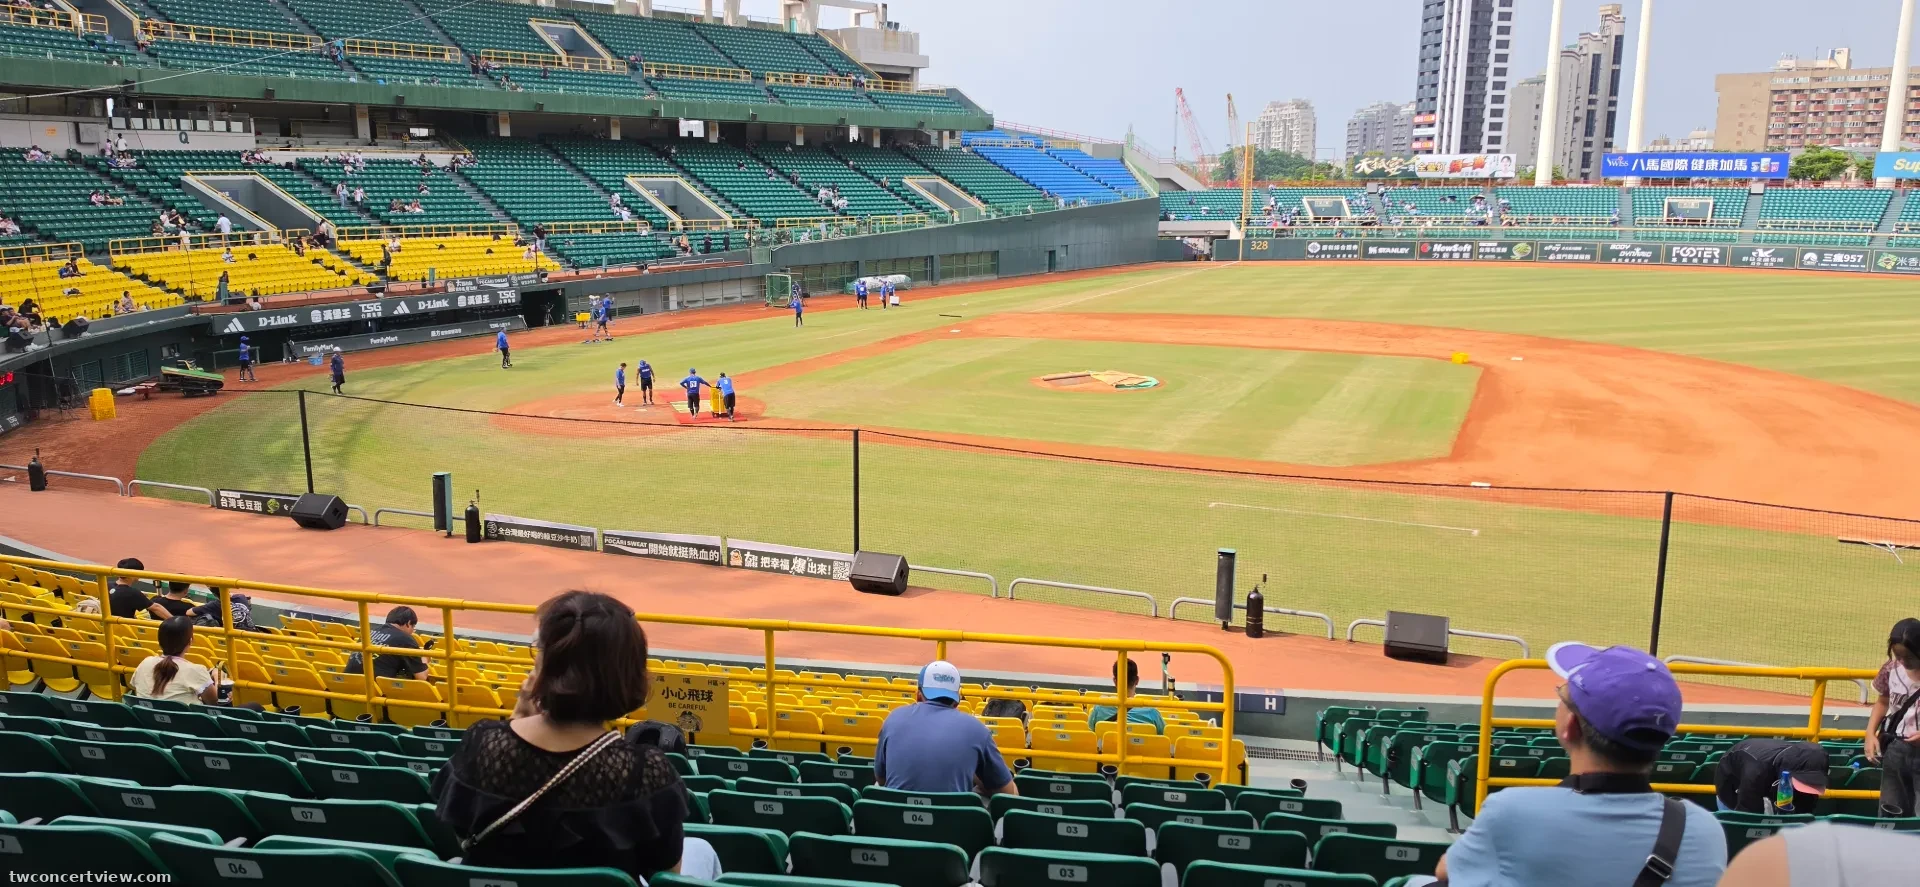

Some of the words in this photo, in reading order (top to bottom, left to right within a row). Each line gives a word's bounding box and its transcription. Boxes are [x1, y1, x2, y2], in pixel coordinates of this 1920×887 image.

[179, 131, 190, 144] Q
[1632, 158, 1688, 172] 八馬國際
[1691, 158, 1748, 172] 健康加馬
[1250, 241, 1269, 250] 328
[1671, 246, 1720, 258] FOOTER
[1896, 256, 1920, 267] 米香
[496, 290, 516, 299] TSG
[359, 303, 382, 312] TSG
[417, 299, 450, 310] D-Link
[258, 314, 297, 327] D-Link
[370, 335, 398, 345] FamilyMart
[303, 343, 334, 353] FamilyMart
[220, 496, 263, 512] 台灣毛豆甜
[605, 538, 626, 546] POCARI
[648, 542, 720, 562] 開始就挺熱血的
[707, 679, 719, 687] H區
[661, 686, 714, 702] 小心飛球
[678, 703, 707, 711] CAREFUL
[1264, 697, 1277, 711] H
[88, 748, 97, 757] 10
[211, 759, 222, 767] 09
[339, 773, 350, 781] 08
[131, 796, 145, 807] 08
[762, 803, 774, 812] 05
[300, 810, 314, 821] 07
[911, 813, 924, 823] 04
[1066, 826, 1078, 834] 03
[1227, 838, 1240, 847] 02
[861, 852, 877, 863] 04
[1396, 850, 1407, 858] 01
[228, 861, 248, 875] 06
[1059, 868, 1075, 878] 03
